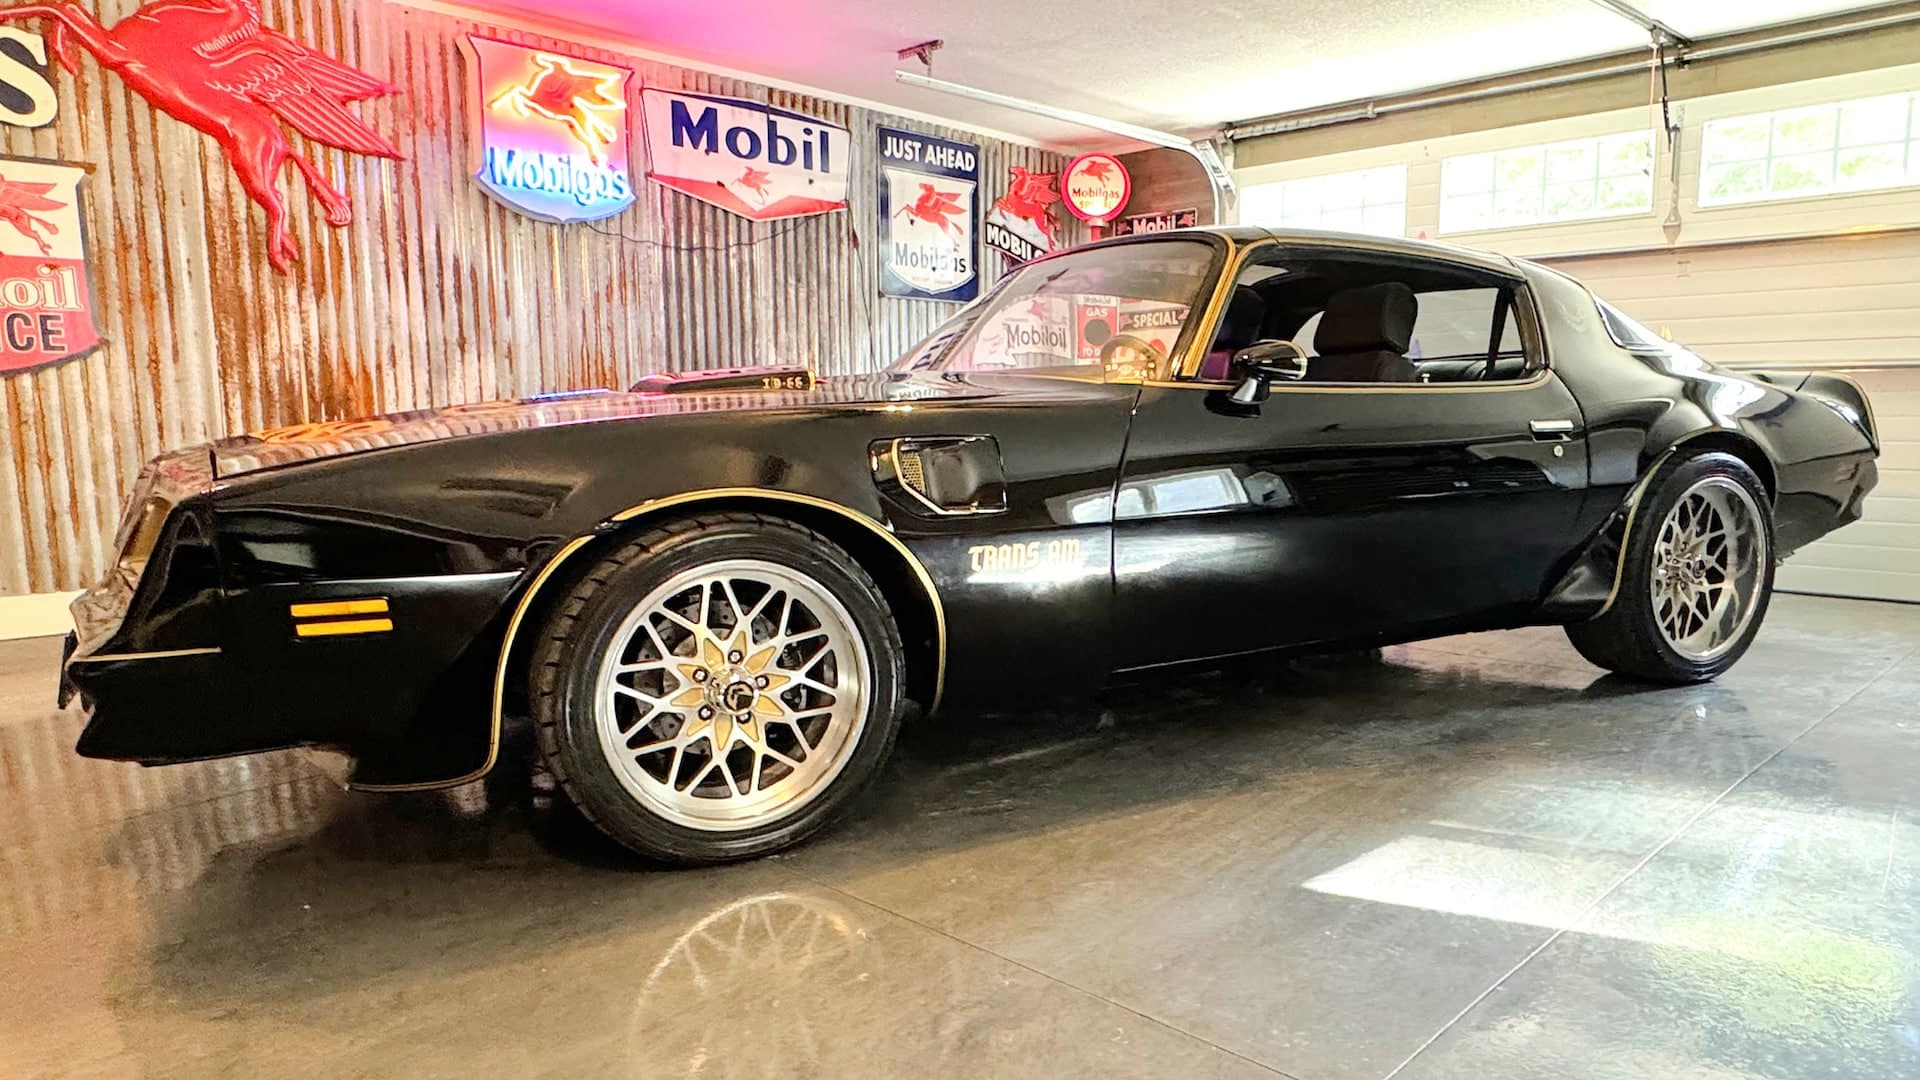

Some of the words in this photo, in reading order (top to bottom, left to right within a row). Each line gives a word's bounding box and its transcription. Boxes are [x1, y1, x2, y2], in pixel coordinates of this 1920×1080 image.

[670, 99, 831, 174] Mobil
[883, 136, 921, 162] JUST
[925, 144, 976, 173] AHEAD
[489, 147, 629, 207] Mobilgas
[1072, 186, 1120, 200] Mobilgas
[1132, 214, 1177, 235] Mobil
[895, 241, 967, 274] Mobils
[0, 264, 84, 311] oil
[1086, 307, 1109, 317] GAS
[1132, 309, 1180, 329] SPECIAL
[1007, 323, 1067, 351] Mobiloil
[968, 541, 1041, 572] TRANS
[1048, 539, 1080, 564] AM
